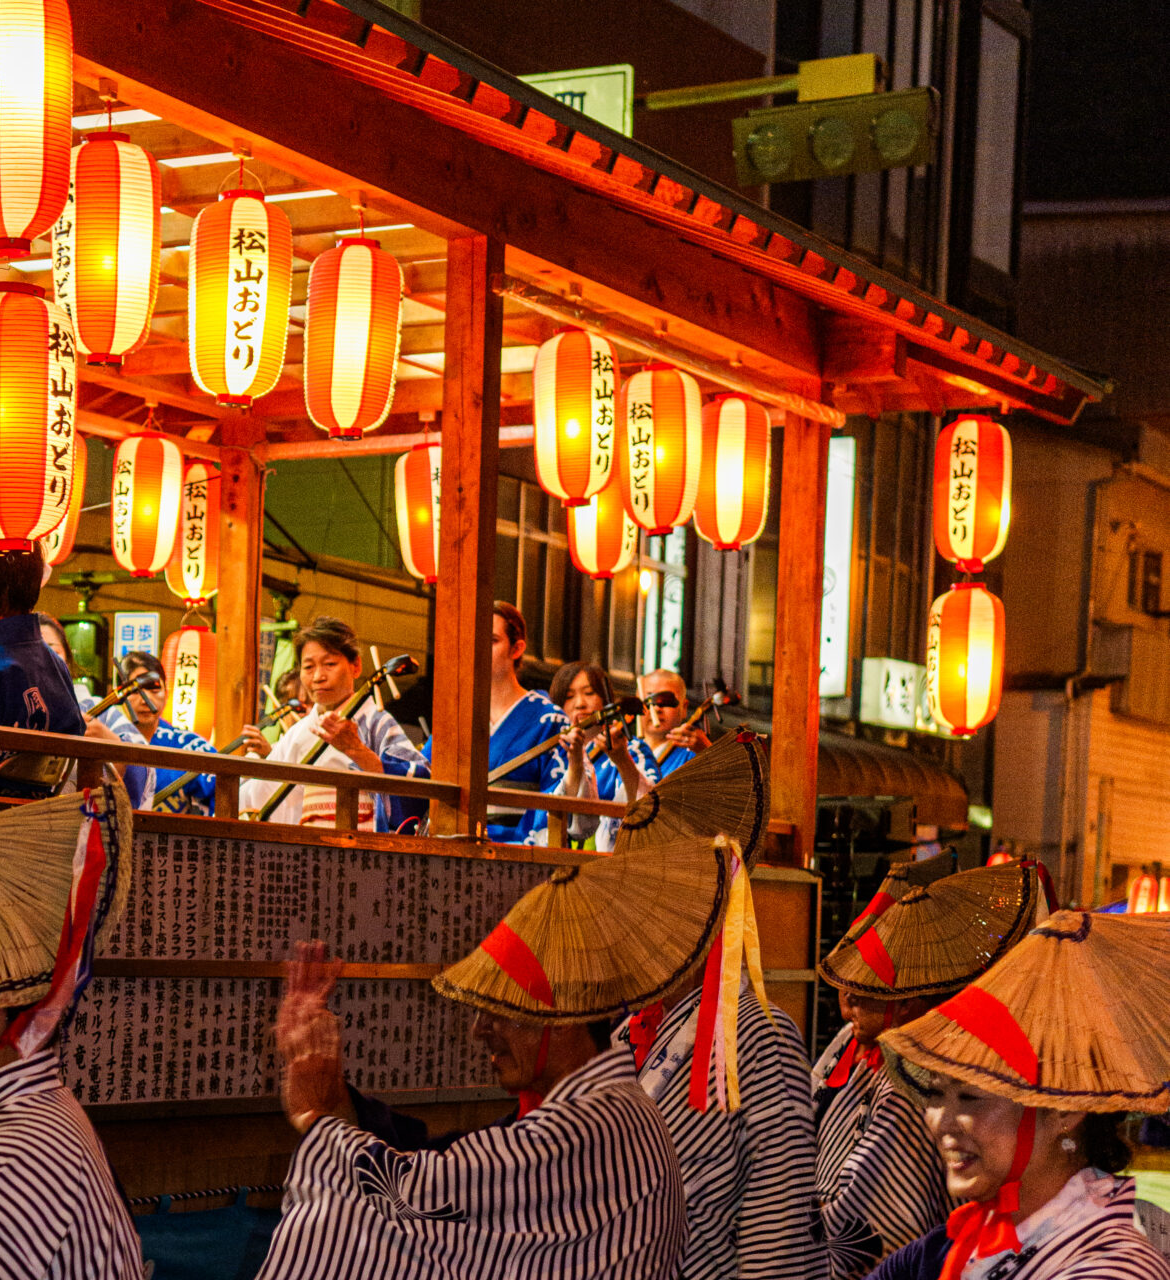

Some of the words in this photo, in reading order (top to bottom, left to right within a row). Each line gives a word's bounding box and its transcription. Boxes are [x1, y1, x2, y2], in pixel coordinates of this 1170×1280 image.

[233, 228, 266, 371] 松山おどり
[48, 322, 75, 507] 松山おどり
[140, 840, 154, 957] 高梁文化協会
